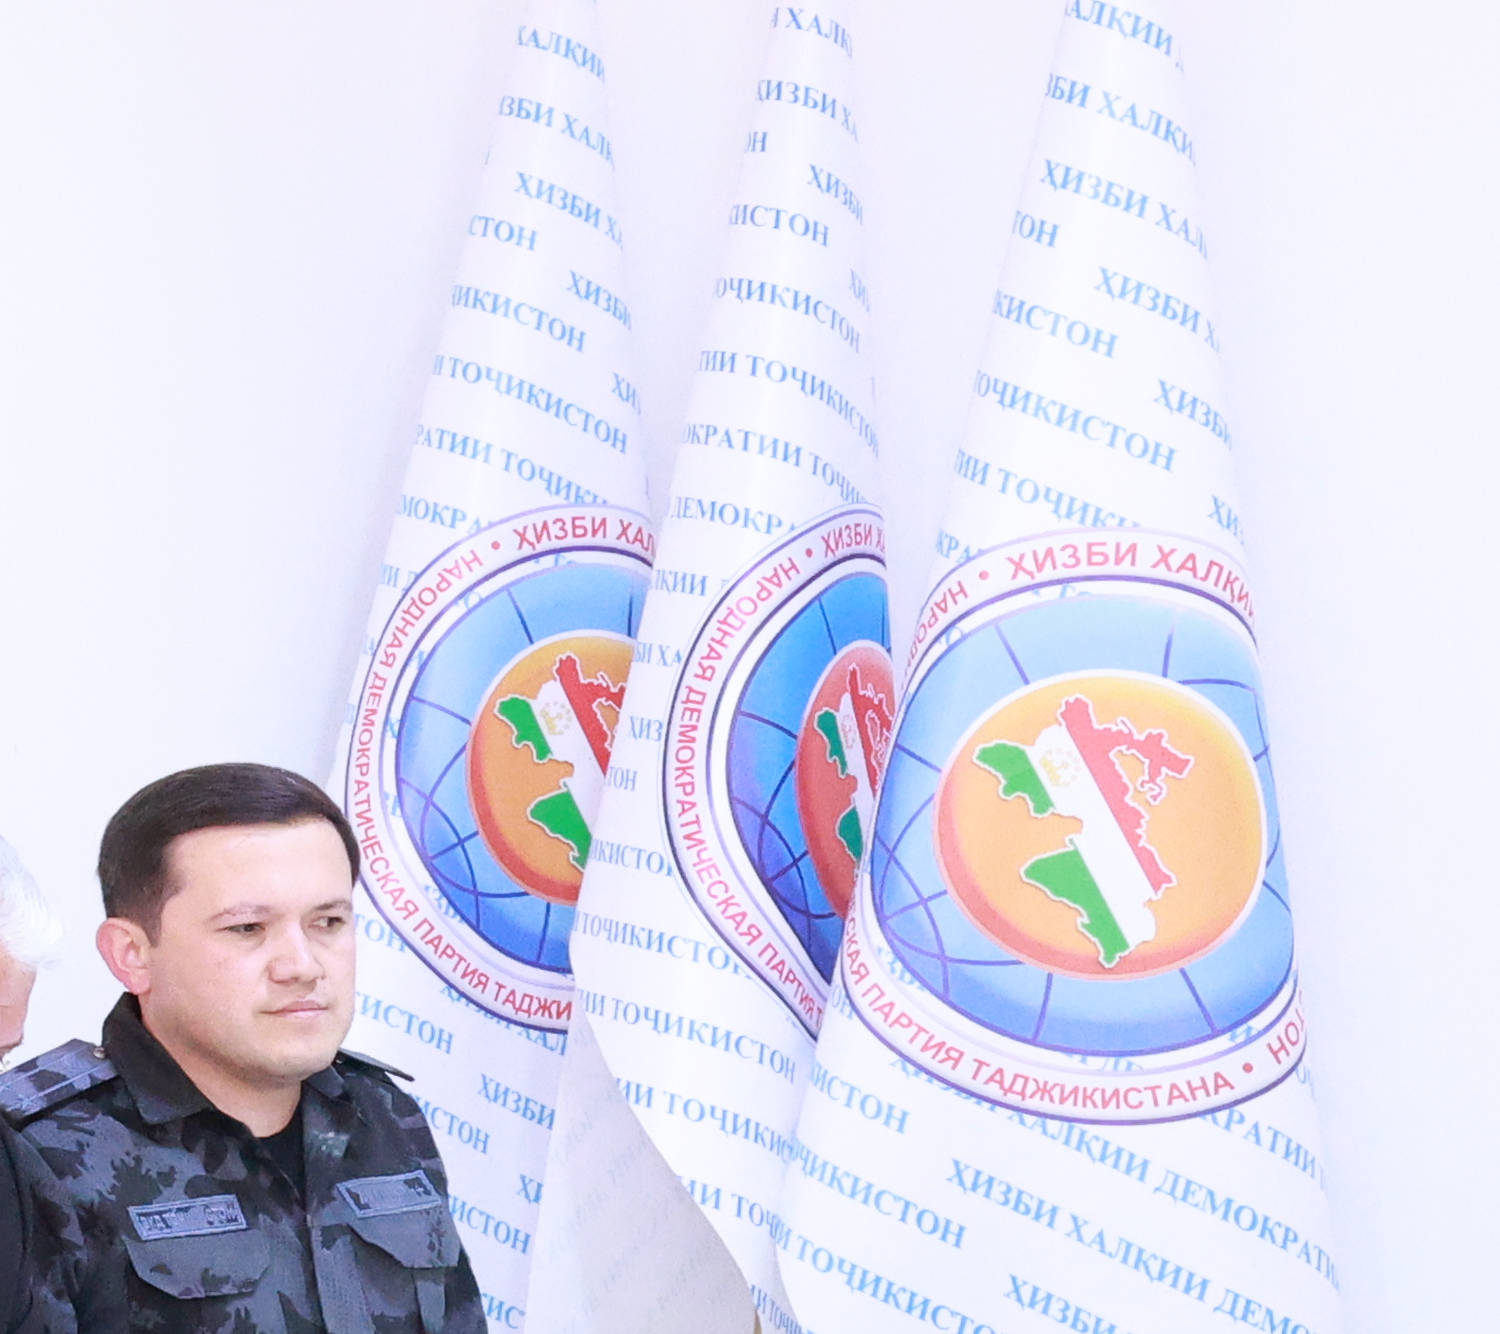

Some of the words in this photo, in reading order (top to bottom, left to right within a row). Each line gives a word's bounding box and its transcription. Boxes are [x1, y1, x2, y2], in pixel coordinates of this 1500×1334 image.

[1038, 158, 1152, 220] ҲИЗБИ
[1093, 265, 1203, 336] ҲИЗБИ
[448, 356, 629, 456] ТОҶИКИСТОН
[379, 548, 485, 671] НАРОДНАЯ
[1004, 541, 1139, 582] ҲИЗБИ
[693, 556, 802, 682] НАРОДНАЯ
[353, 670, 420, 921] ДЕМОКРАТИЧЕСКАЯ
[674, 684, 763, 947] ДЕМОКРАТИЧЕСКАЯ
[412, 917, 492, 995] ПАРТИЯ
[611, 996, 796, 1085] ТОҶИКИСТОН
[860, 981, 966, 1071] ПАРТИЯ
[970, 1057, 1236, 1111] ТАДЖИКИСТАНА
[946, 1156, 1061, 1231] ҲИЗБИ
[1064, 1212, 1213, 1305] ХАЛҚИИ
